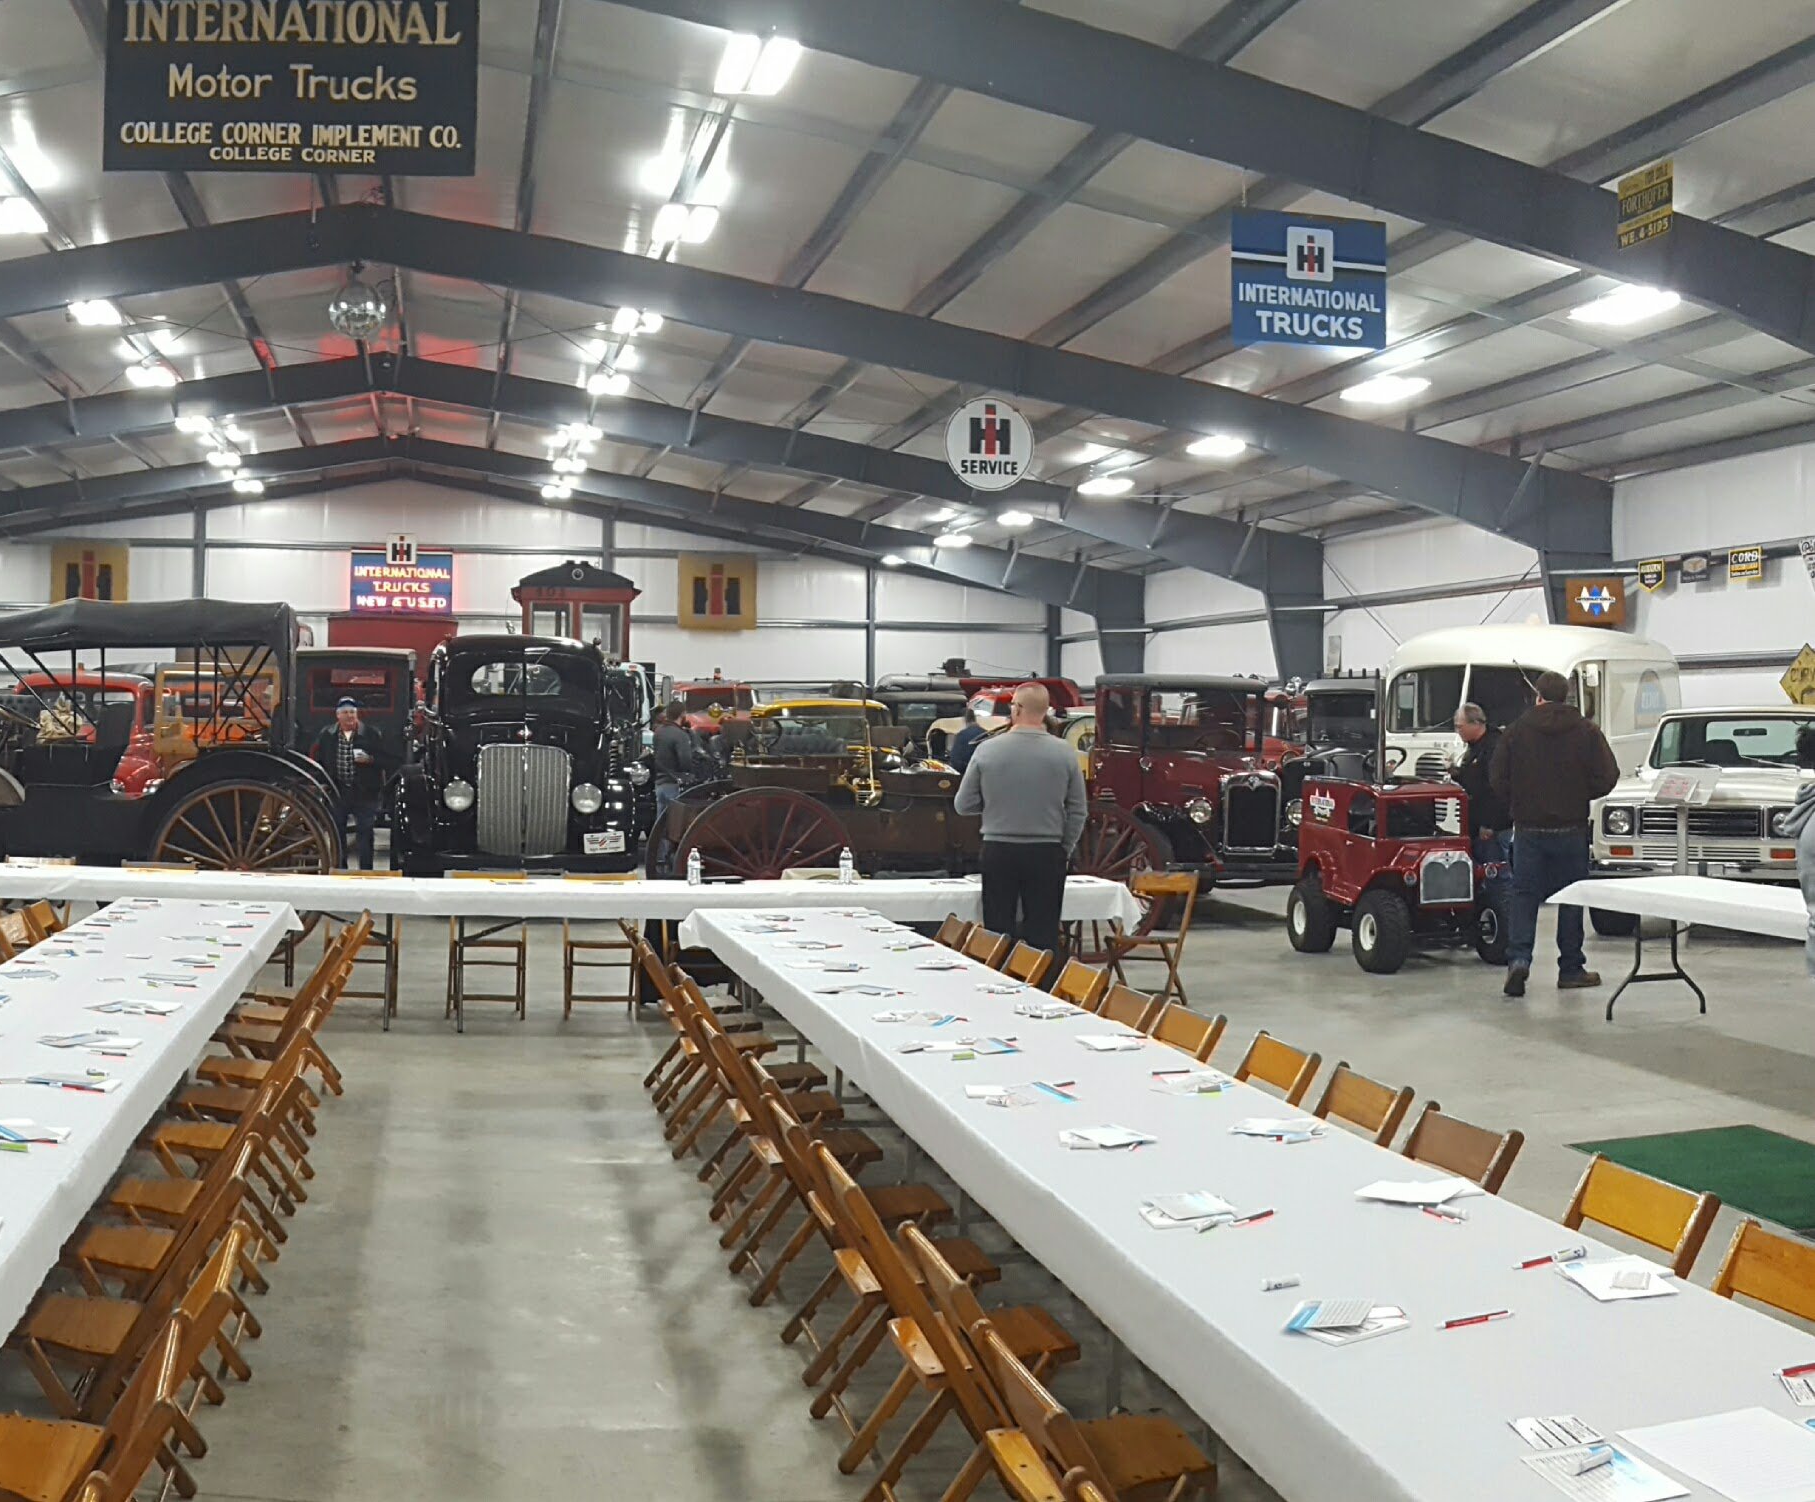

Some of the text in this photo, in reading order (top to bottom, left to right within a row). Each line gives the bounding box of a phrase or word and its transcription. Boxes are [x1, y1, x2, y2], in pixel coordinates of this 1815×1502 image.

[123, 0, 461, 46] INTERNATIONAL
[168, 62, 418, 101] Motor Trucks
[120, 121, 462, 149] COLLEGE CORNER IMPLEMENT CO.
[209, 146, 376, 165] COLLEGE CORNER
[1238, 282, 1382, 313] INTERNATIONAL
[1255, 309, 1364, 341] TRUCKS
[960, 459, 1018, 476] SERVICE
[1731, 551, 1758, 564] CORD
[354, 565, 451, 579] INTERNATIONAL
[372, 581, 430, 593] TRUCKS
[356, 595, 387, 607] NEW
[406, 597, 447, 608] USED
